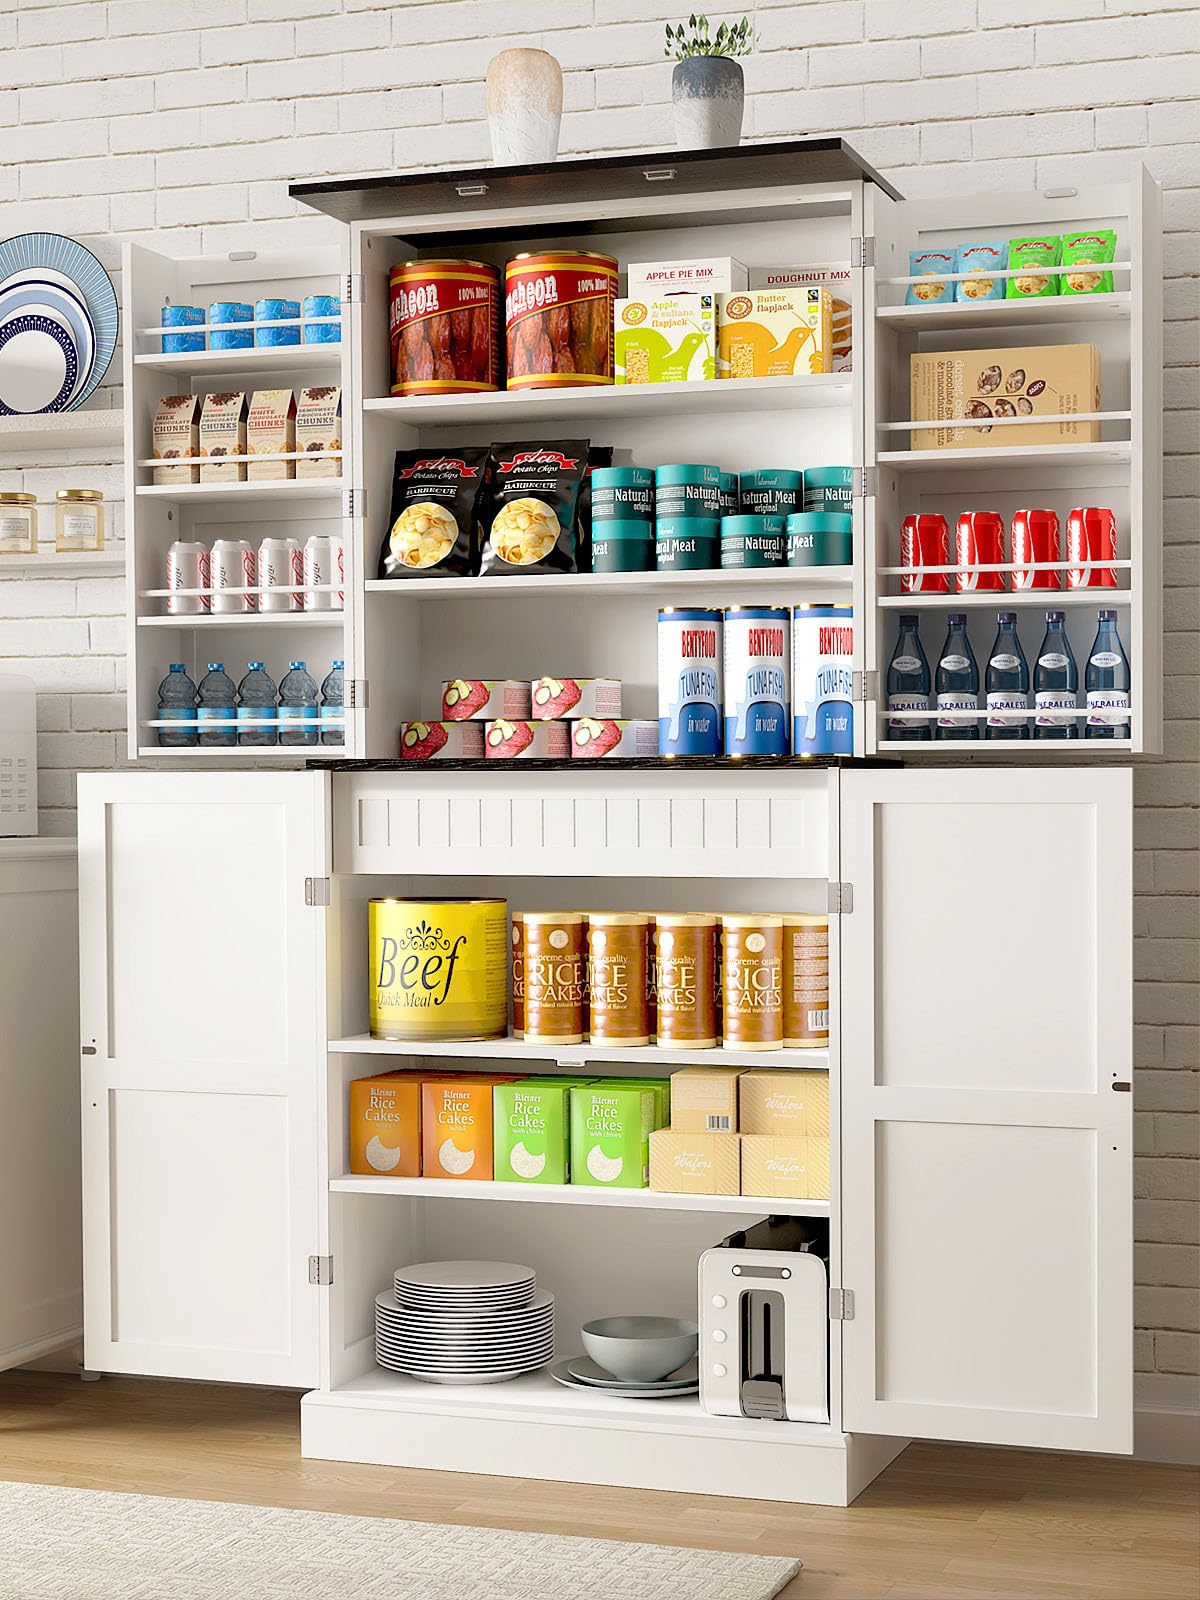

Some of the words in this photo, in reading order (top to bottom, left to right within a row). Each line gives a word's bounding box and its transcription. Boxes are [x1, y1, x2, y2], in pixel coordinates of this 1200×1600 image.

[646, 270, 676, 280] APPLE
[678, 270, 694, 278] PIE
[696, 268, 714, 277] MIX
[767, 272, 828, 284] DOUGHNUT
[830, 270, 851, 280] MIX
[652, 300, 678, 310] Apple
[757, 303, 794, 312] flapjack
[652, 318, 688, 328] flapjack
[201, 422, 237, 430] CHUNKS
[248, 420, 285, 428] CHUNKS
[297, 417, 334, 425] CHUNKS
[438, 472, 459, 480] Chips
[513, 466, 536, 474] Potato
[537, 465, 559, 474] Chips
[406, 488, 457, 496] BARBECUE
[504, 482, 557, 490] BARBECUE
[615, 488, 649, 502] Natural
[686, 486, 718, 500] Natural
[742, 490, 772, 504] Natural
[775, 490, 796, 504] Meat
[754, 504, 778, 514] original
[672, 539, 696, 552] Meat
[745, 536, 779, 550] Natural
[604, 954, 628, 964] quality
[670, 957, 696, 966] quality
[377, 936, 467, 1005] Beef
[531, 963, 581, 985] RICE
[728, 968, 780, 990] RICE
[531, 985, 582, 1001] CAKES
[728, 990, 780, 1006] CAKES
[377, 991, 401, 1010] Quick
[404, 992, 432, 1008] Meal
[370, 1096, 395, 1109] Rice
[444, 1099, 469, 1112] Rice
[514, 1102, 540, 1115] Rice
[365, 1108, 400, 1122] Cakes
[438, 1111, 474, 1125] Cakes
[592, 1105, 617, 1118] Rice
[509, 1114, 545, 1128] Cakes
[586, 1117, 623, 1131] Cakes
